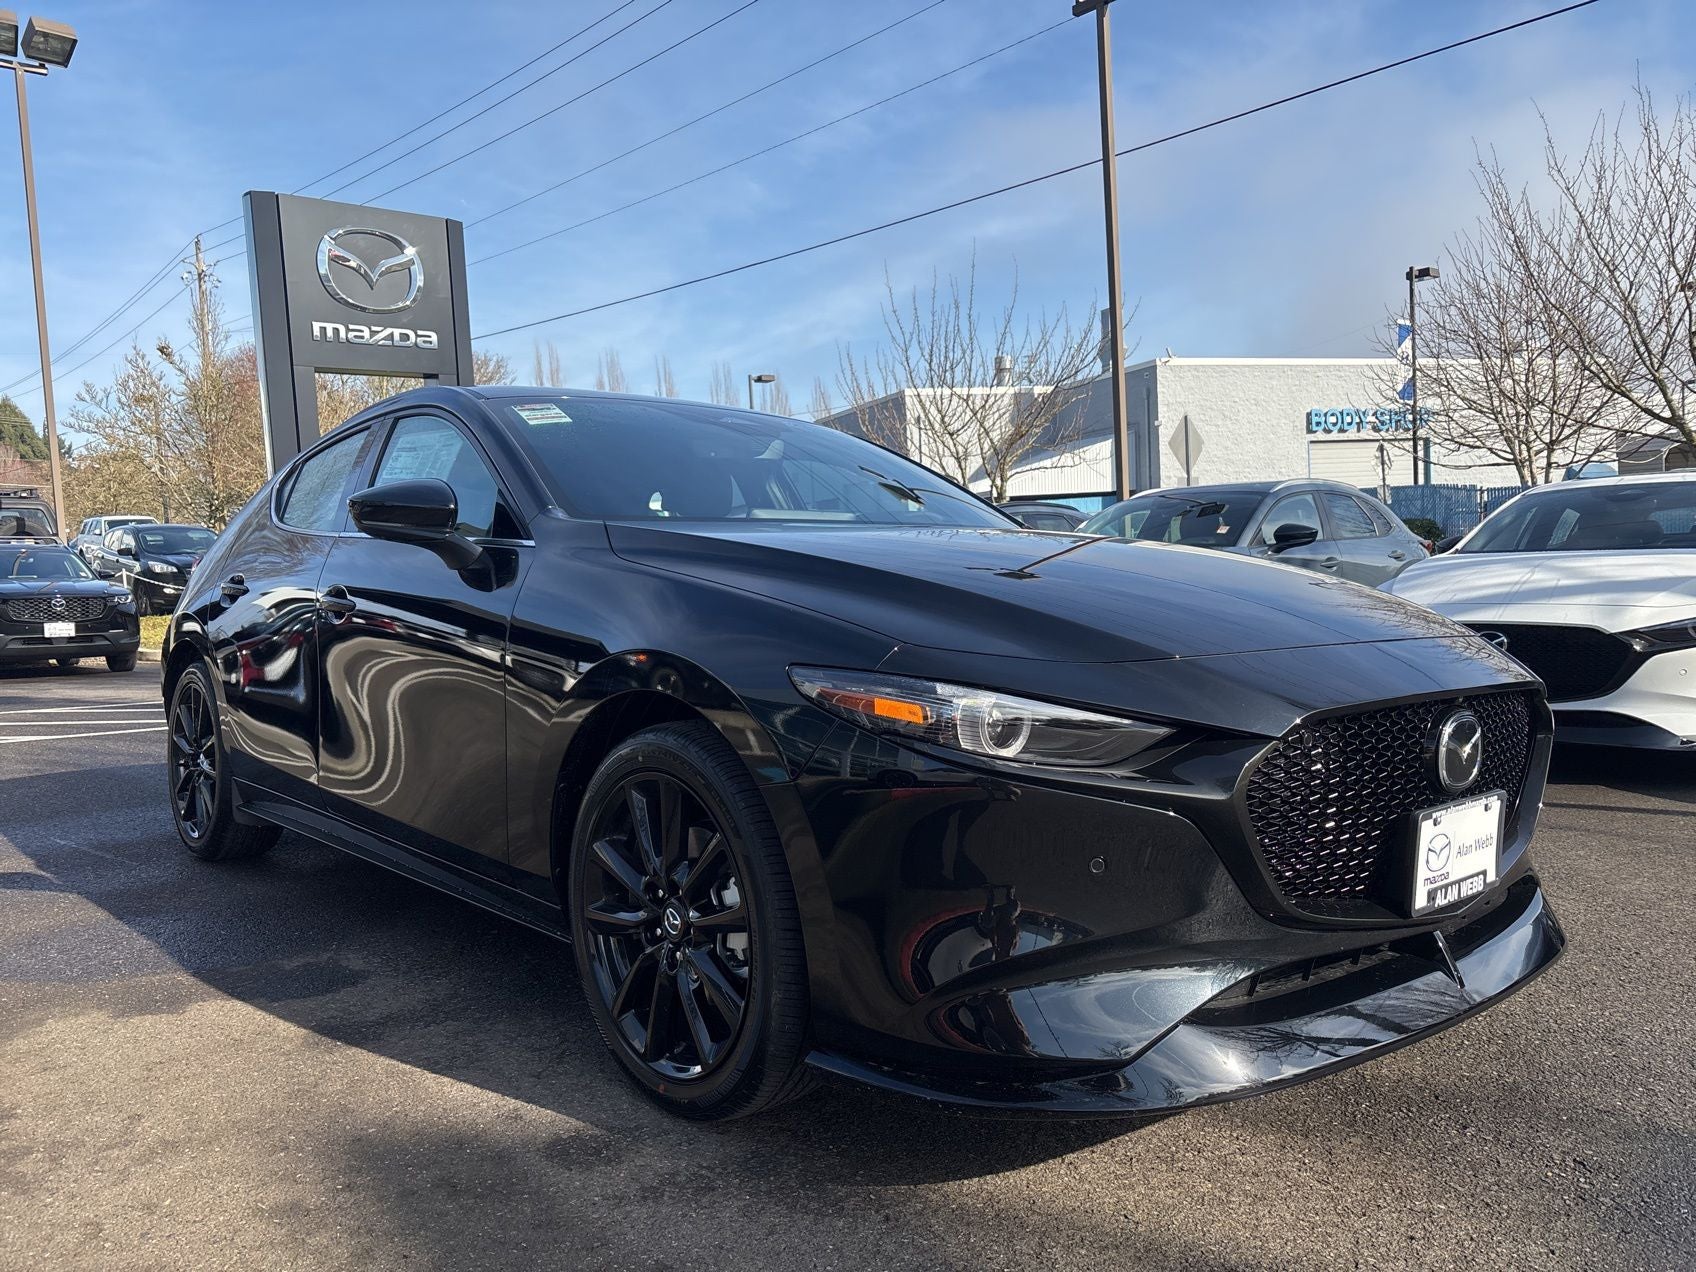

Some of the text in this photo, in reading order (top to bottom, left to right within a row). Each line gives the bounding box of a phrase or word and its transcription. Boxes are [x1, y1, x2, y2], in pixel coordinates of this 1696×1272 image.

[1307, 407, 1431, 433] BODY SHOP
[1456, 833, 1494, 859] Alan Webb
[1434, 874, 1484, 908] ALAN WEBB
